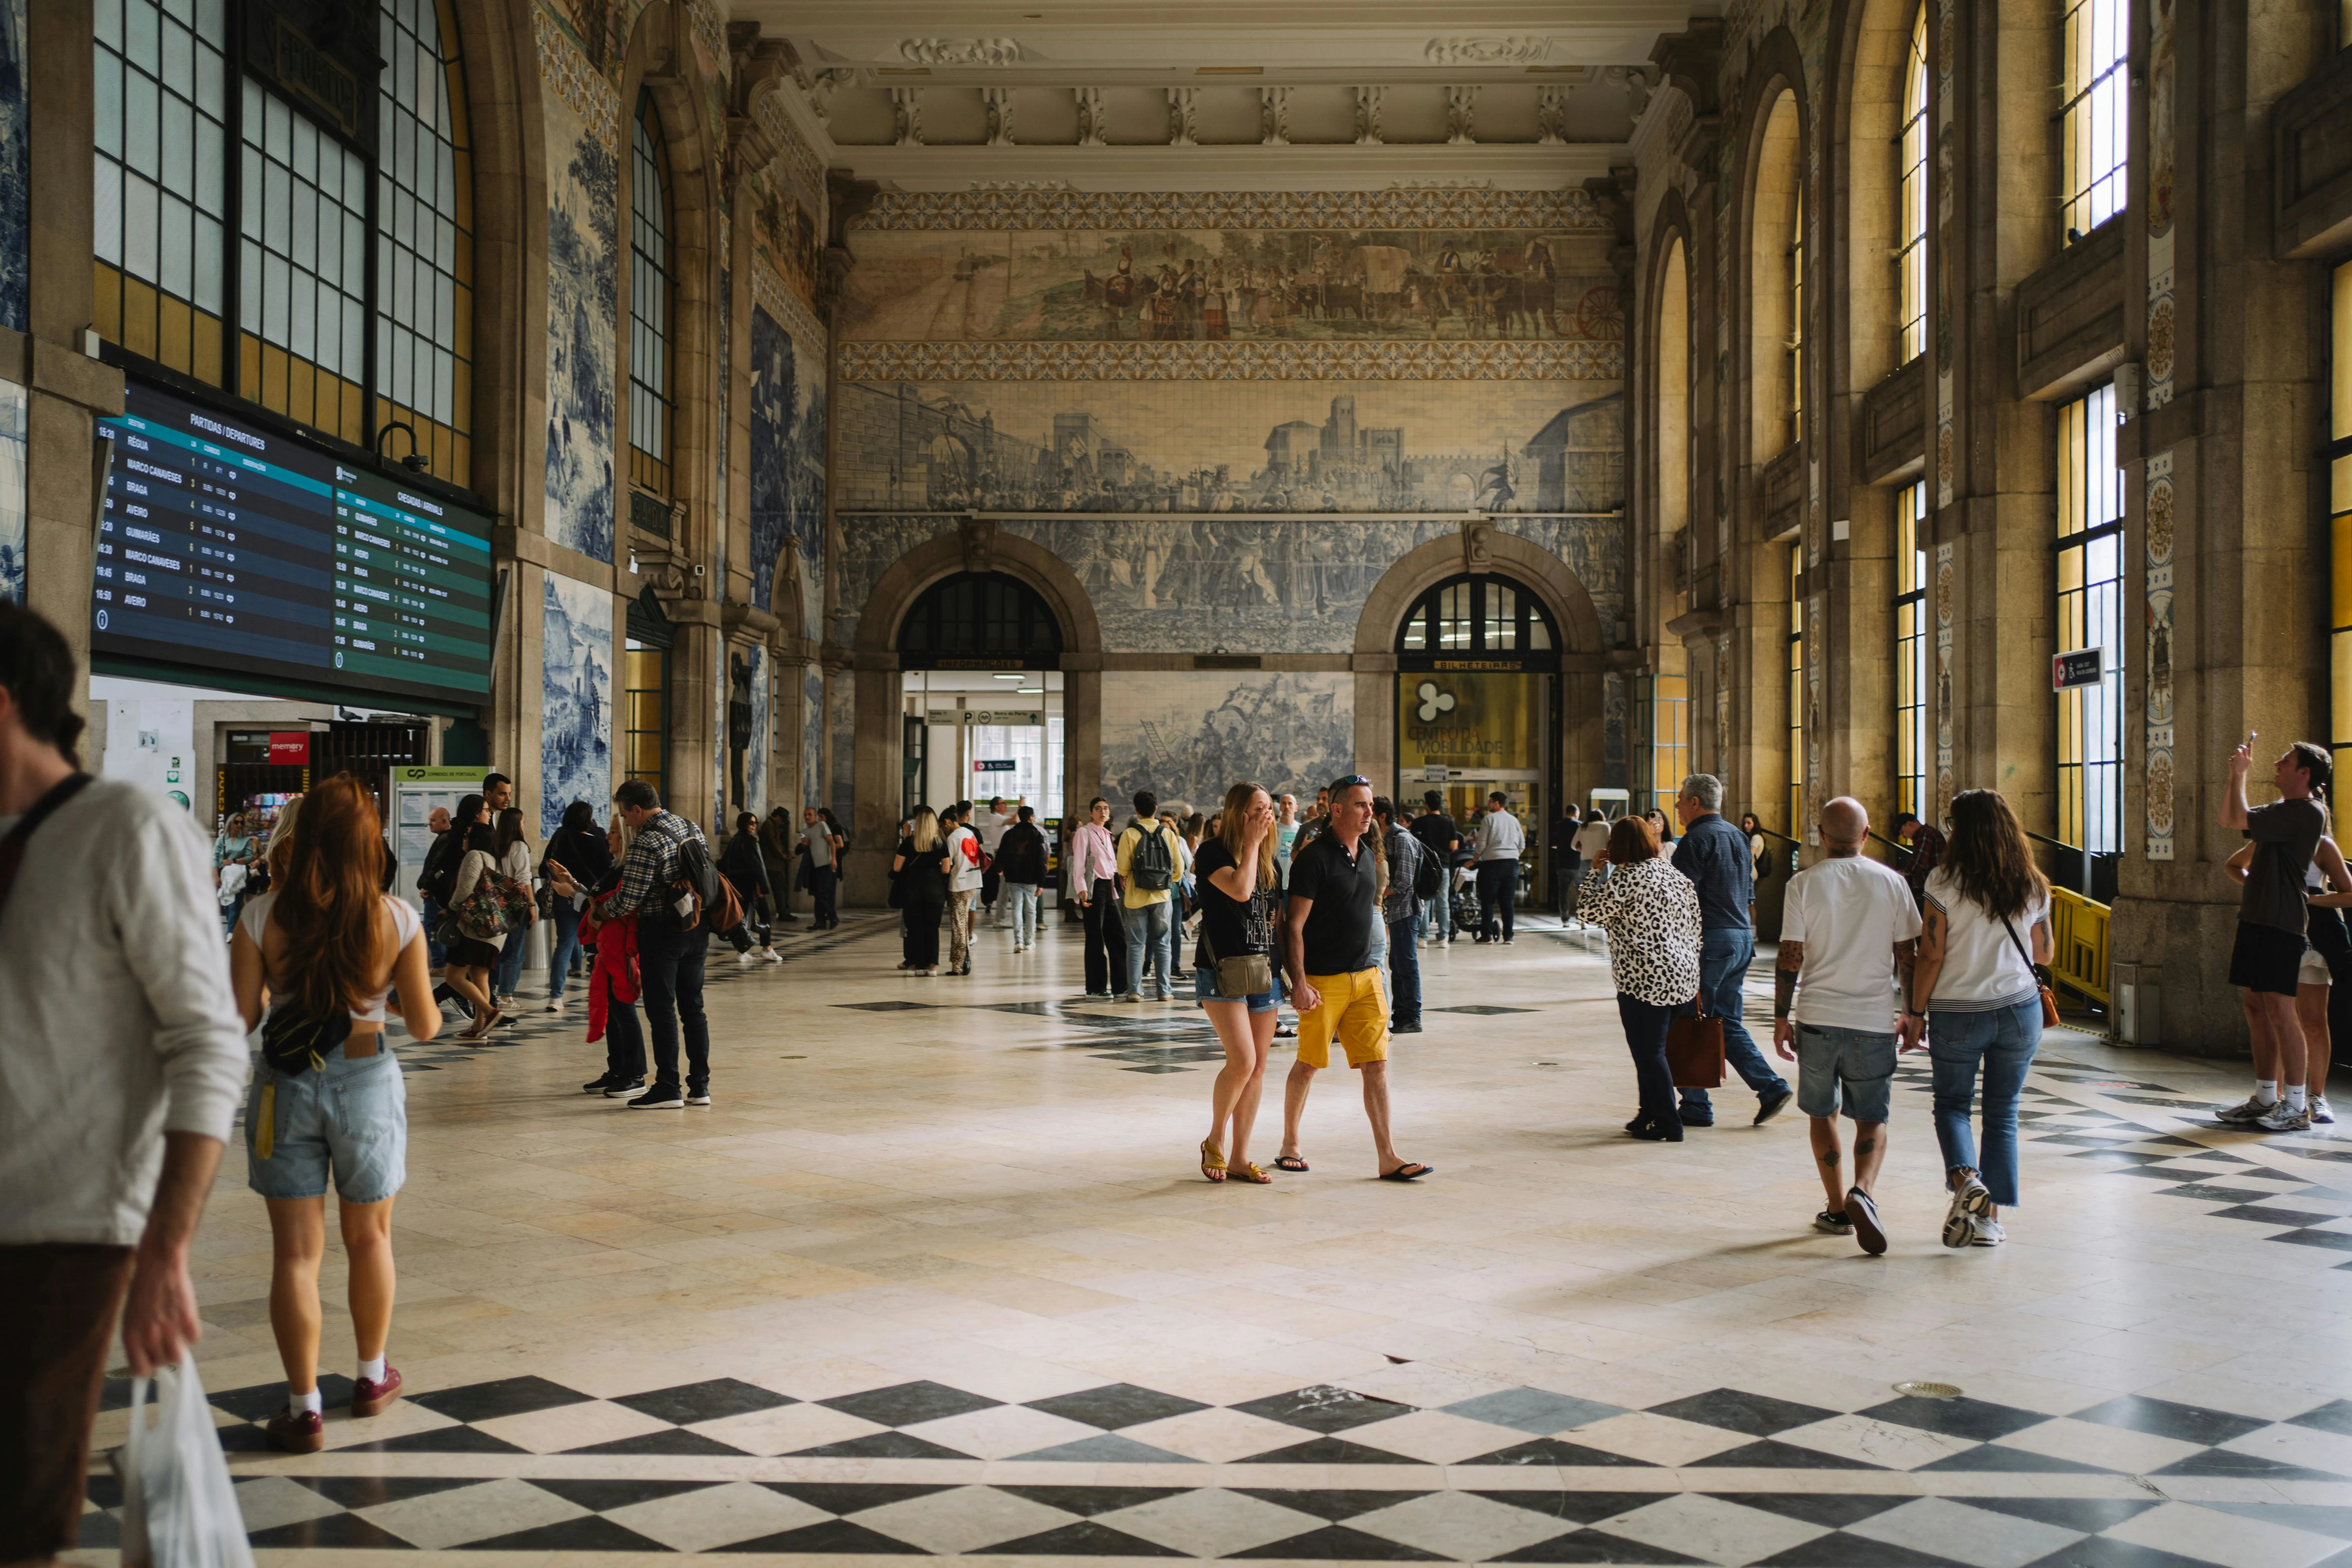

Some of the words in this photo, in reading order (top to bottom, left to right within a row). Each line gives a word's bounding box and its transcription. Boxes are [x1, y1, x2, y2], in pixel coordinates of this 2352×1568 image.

[289, 33, 346, 108] PORTO
[191, 414, 222, 434] PARTIDAS
[226, 427, 265, 450] DEPARTURES
[99, 426, 114, 439] 15:20
[127, 436, 149, 451] RÉGUA
[192, 457, 195, 466] 1
[127, 459, 149, 473] MARCO
[149, 466, 182, 483] CANAVESES
[191, 479, 195, 487] 3
[127, 481, 148, 495] BRAGA
[190, 500, 194, 509] 4
[397, 492, 421, 508] CHEGADAS
[423, 501, 443, 516] ARRIVALS
[126, 504, 148, 518] AVEIRO
[190, 521, 194, 530] 5
[126, 527, 160, 543] GUIMARÃES
[189, 543, 194, 552] 6
[125, 549, 147, 563] MARCO
[147, 555, 180, 570] CANAVESES
[189, 564, 193, 573] 1
[96, 566, 112, 577] 16:45
[125, 572, 146, 585] BRAGA
[189, 586, 192, 594] 3
[96, 589, 112, 601] 16:50
[124, 595, 146, 607] AVEIRO
[188, 607, 192, 616] 1
[272, 743, 303, 751] memory
[1408, 727, 1457, 741] CENTRO
[1417, 740, 1503, 755] MOBILIDADE
